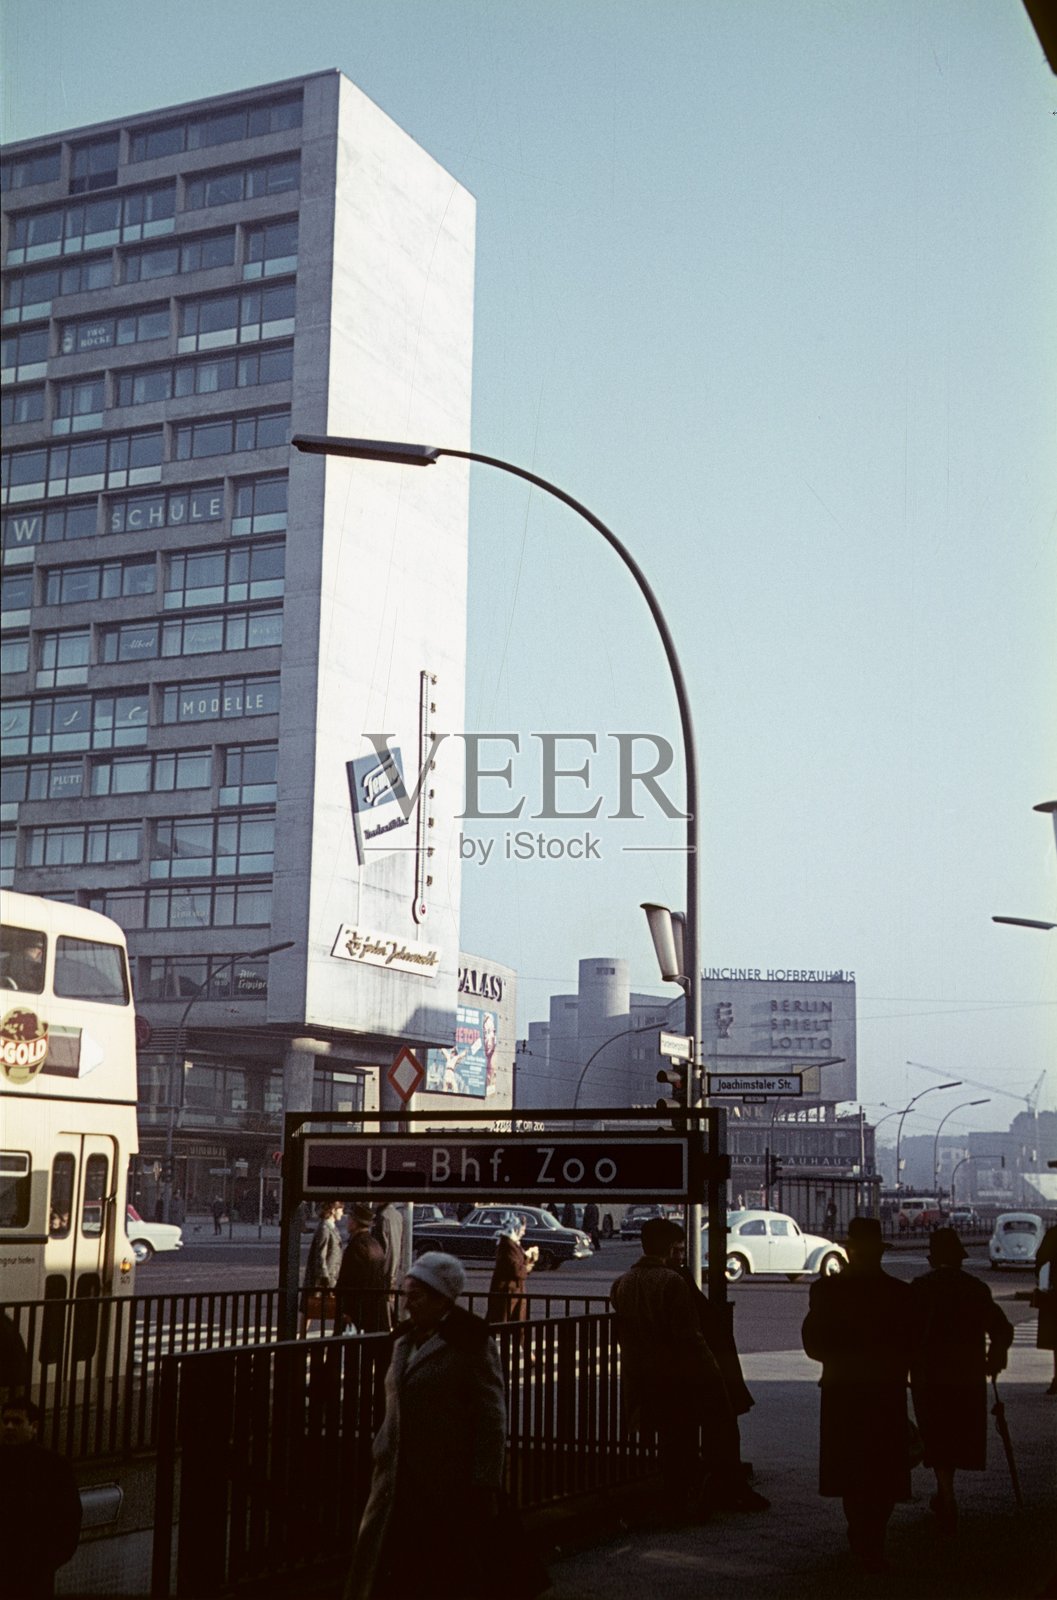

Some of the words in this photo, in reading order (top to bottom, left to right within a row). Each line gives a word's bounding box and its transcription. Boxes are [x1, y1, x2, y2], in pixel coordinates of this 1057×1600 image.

[13, 518, 38, 542] W
[111, 498, 223, 530] SCHULE
[183, 693, 265, 715] MODELLE
[770, 999, 833, 1013] BERLIN
[770, 1018, 833, 1032] SPIELT
[770, 1036, 833, 1050] LOTTO
[717, 1078, 776, 1092] Joachimstaler
[778, 1078, 793, 1090] Str.
[535, 1147, 618, 1183] Zoo
